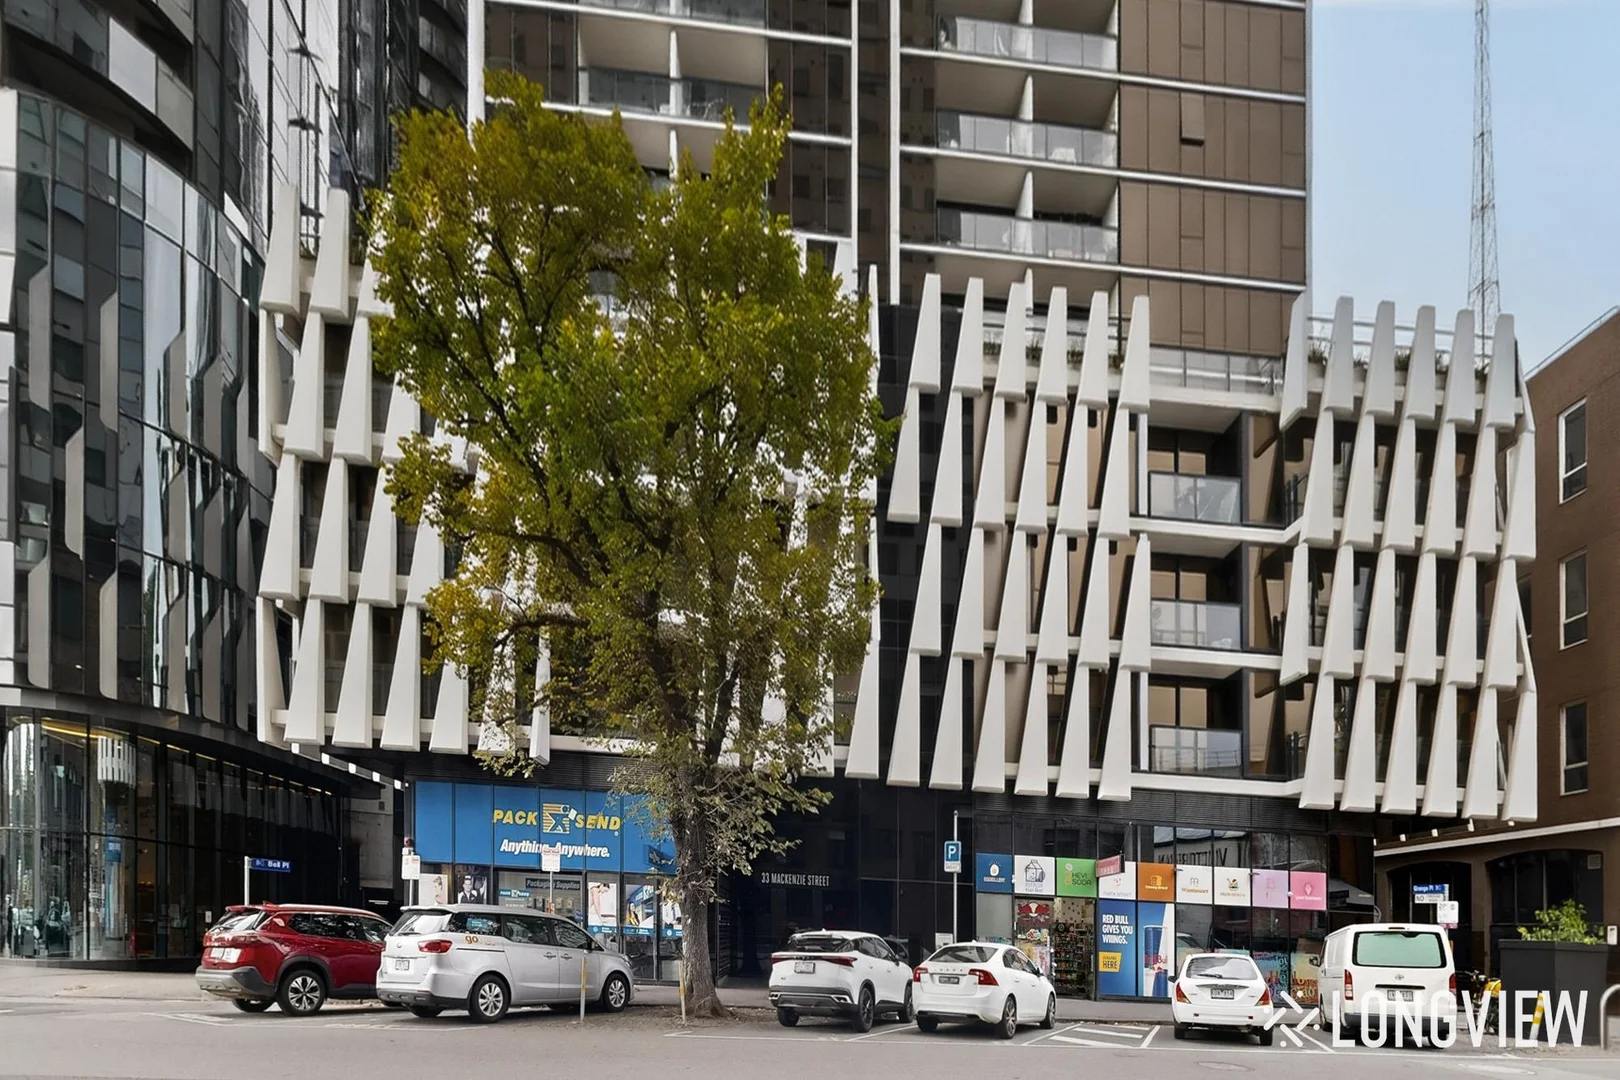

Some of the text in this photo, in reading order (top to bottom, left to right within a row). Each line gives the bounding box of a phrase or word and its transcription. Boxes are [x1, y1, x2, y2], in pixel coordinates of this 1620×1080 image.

[493, 809, 622, 831] PACK SEND
[948, 845, 957, 860] P
[761, 872, 830, 887] 33 MACKENZIE STREET
[556, 881, 580, 890] Supplies
[1102, 914, 1129, 925] RED BULL
[1102, 924, 1134, 935] GIVES YOU
[1102, 961, 1118, 970] HERE
